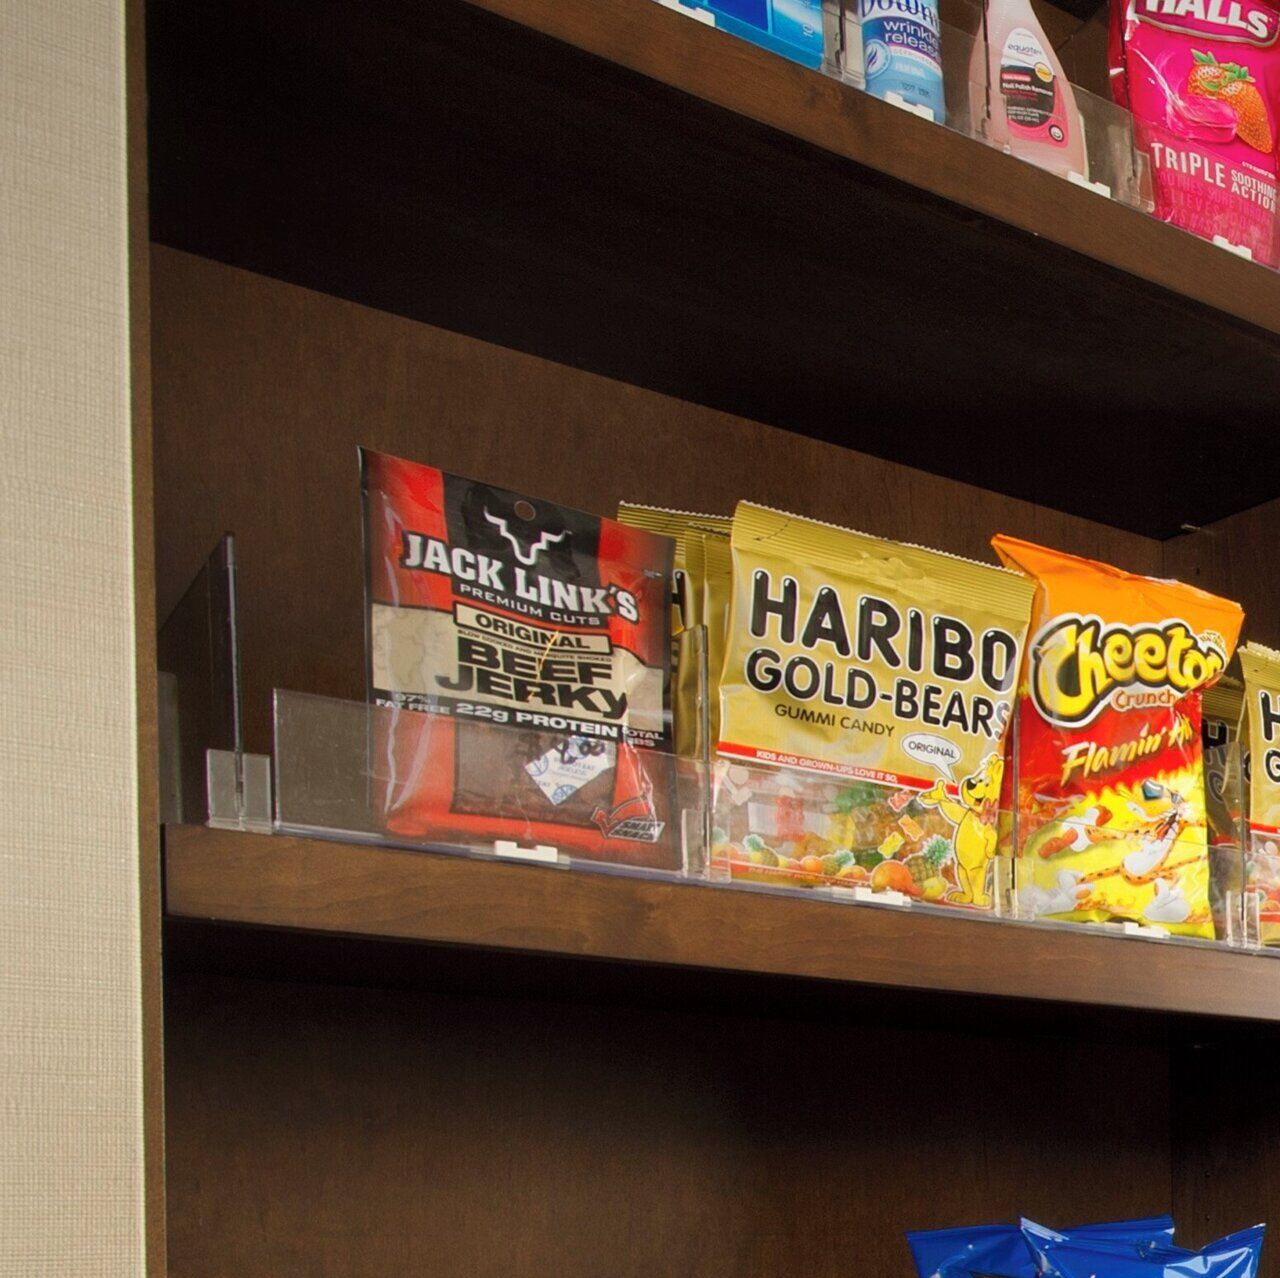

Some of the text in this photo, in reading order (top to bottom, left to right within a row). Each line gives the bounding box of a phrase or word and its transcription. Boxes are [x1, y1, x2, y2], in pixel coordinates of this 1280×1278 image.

[1030, 86, 1054, 97] Remover
[1151, 142, 1225, 188] TRIPLE
[404, 532, 640, 625] JACK LINK'S
[460, 583, 601, 626] PREMIUM CUTS
[475, 613, 592, 650] ORIGINAL
[750, 569, 1017, 693] HARIBO
[457, 635, 613, 683] BEEF
[376, 698, 451, 715] FAT FREE
[434, 664, 629, 719] JERKY
[745, 648, 1012, 741] GOLD-BEARS
[1114, 689, 1180, 709] Crunch
[456, 703, 618, 738] 22g PROTEIN
[774, 703, 895, 738] GUMMI CANDY
[756, 750, 876, 779] KIDS AND GROWN-UPS LOVE
[907, 739, 957, 760] ORIGINAL
[1060, 723, 1168, 788] Flamin'
